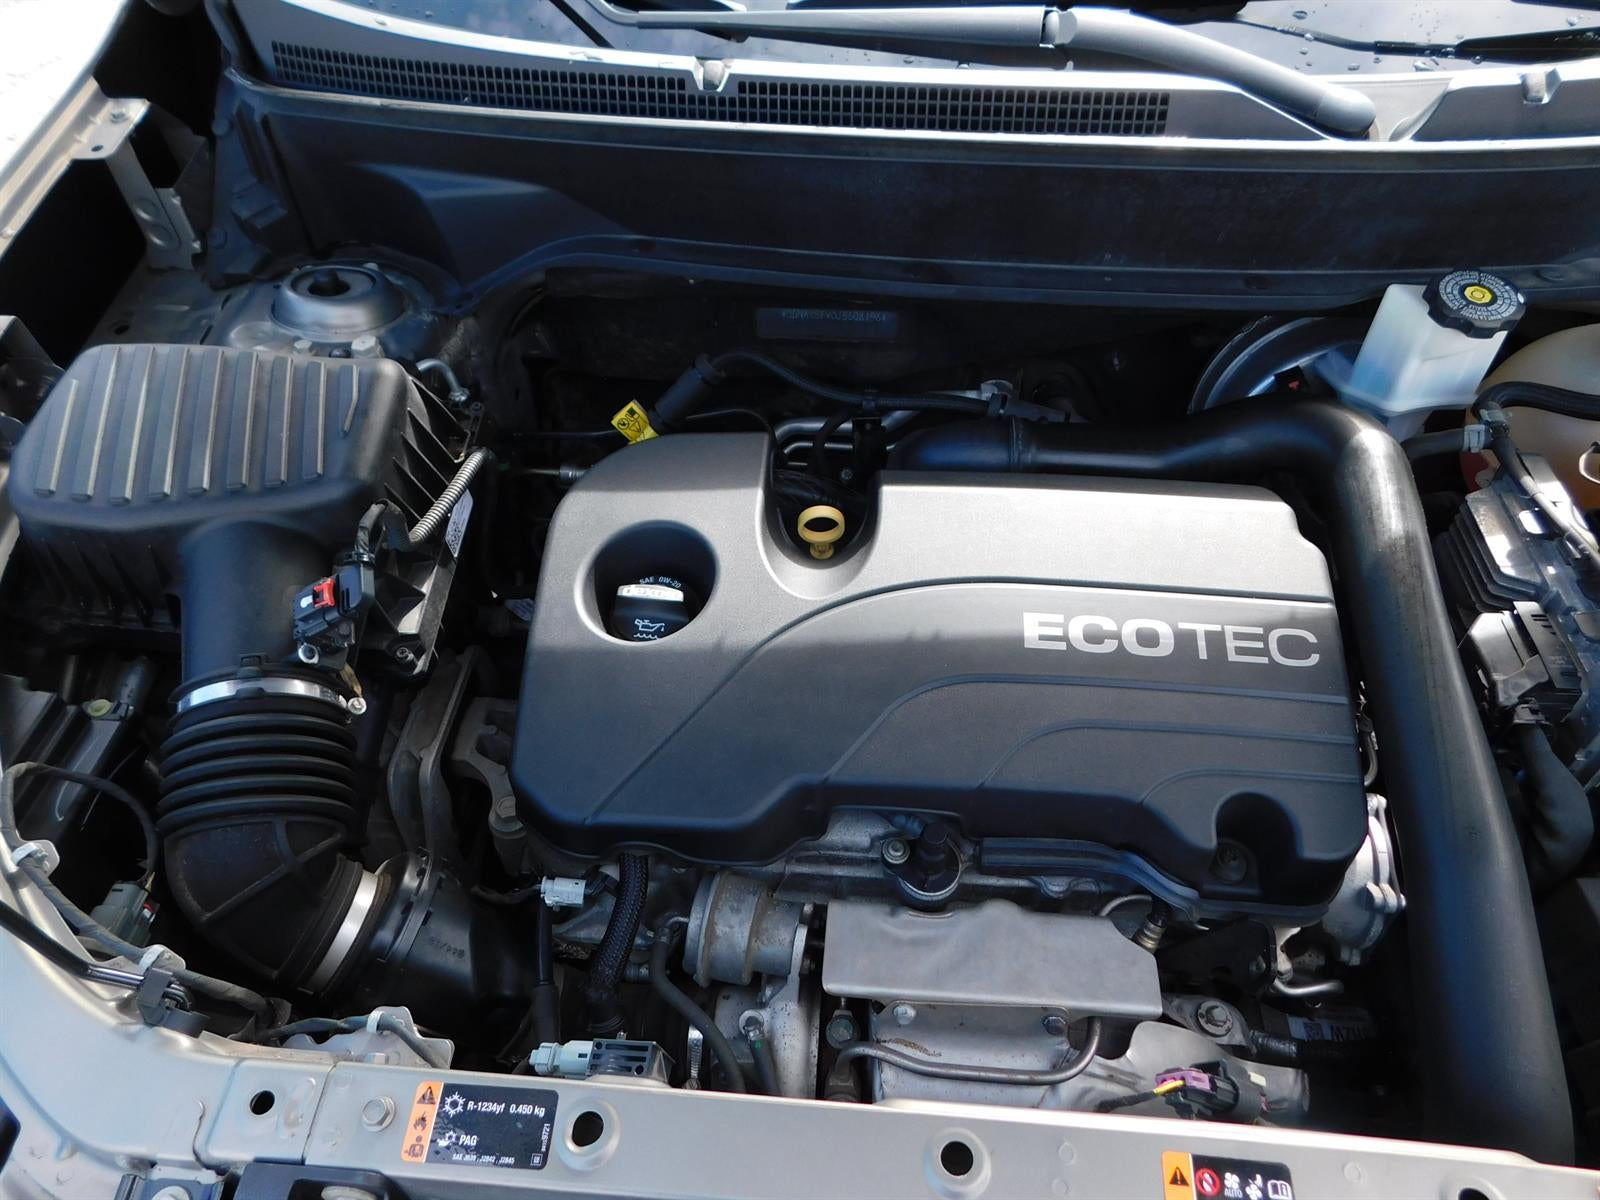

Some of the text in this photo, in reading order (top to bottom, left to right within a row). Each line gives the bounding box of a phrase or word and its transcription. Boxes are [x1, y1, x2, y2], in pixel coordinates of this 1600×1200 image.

[639, 576, 655, 584] SAE
[1023, 612, 1320, 667] ECOTEC
[467, 1101, 546, 1117] R-1234yf 0.450 kg
[458, 1134, 478, 1146] PAG
[1224, 1188, 1243, 1198] AUTO
